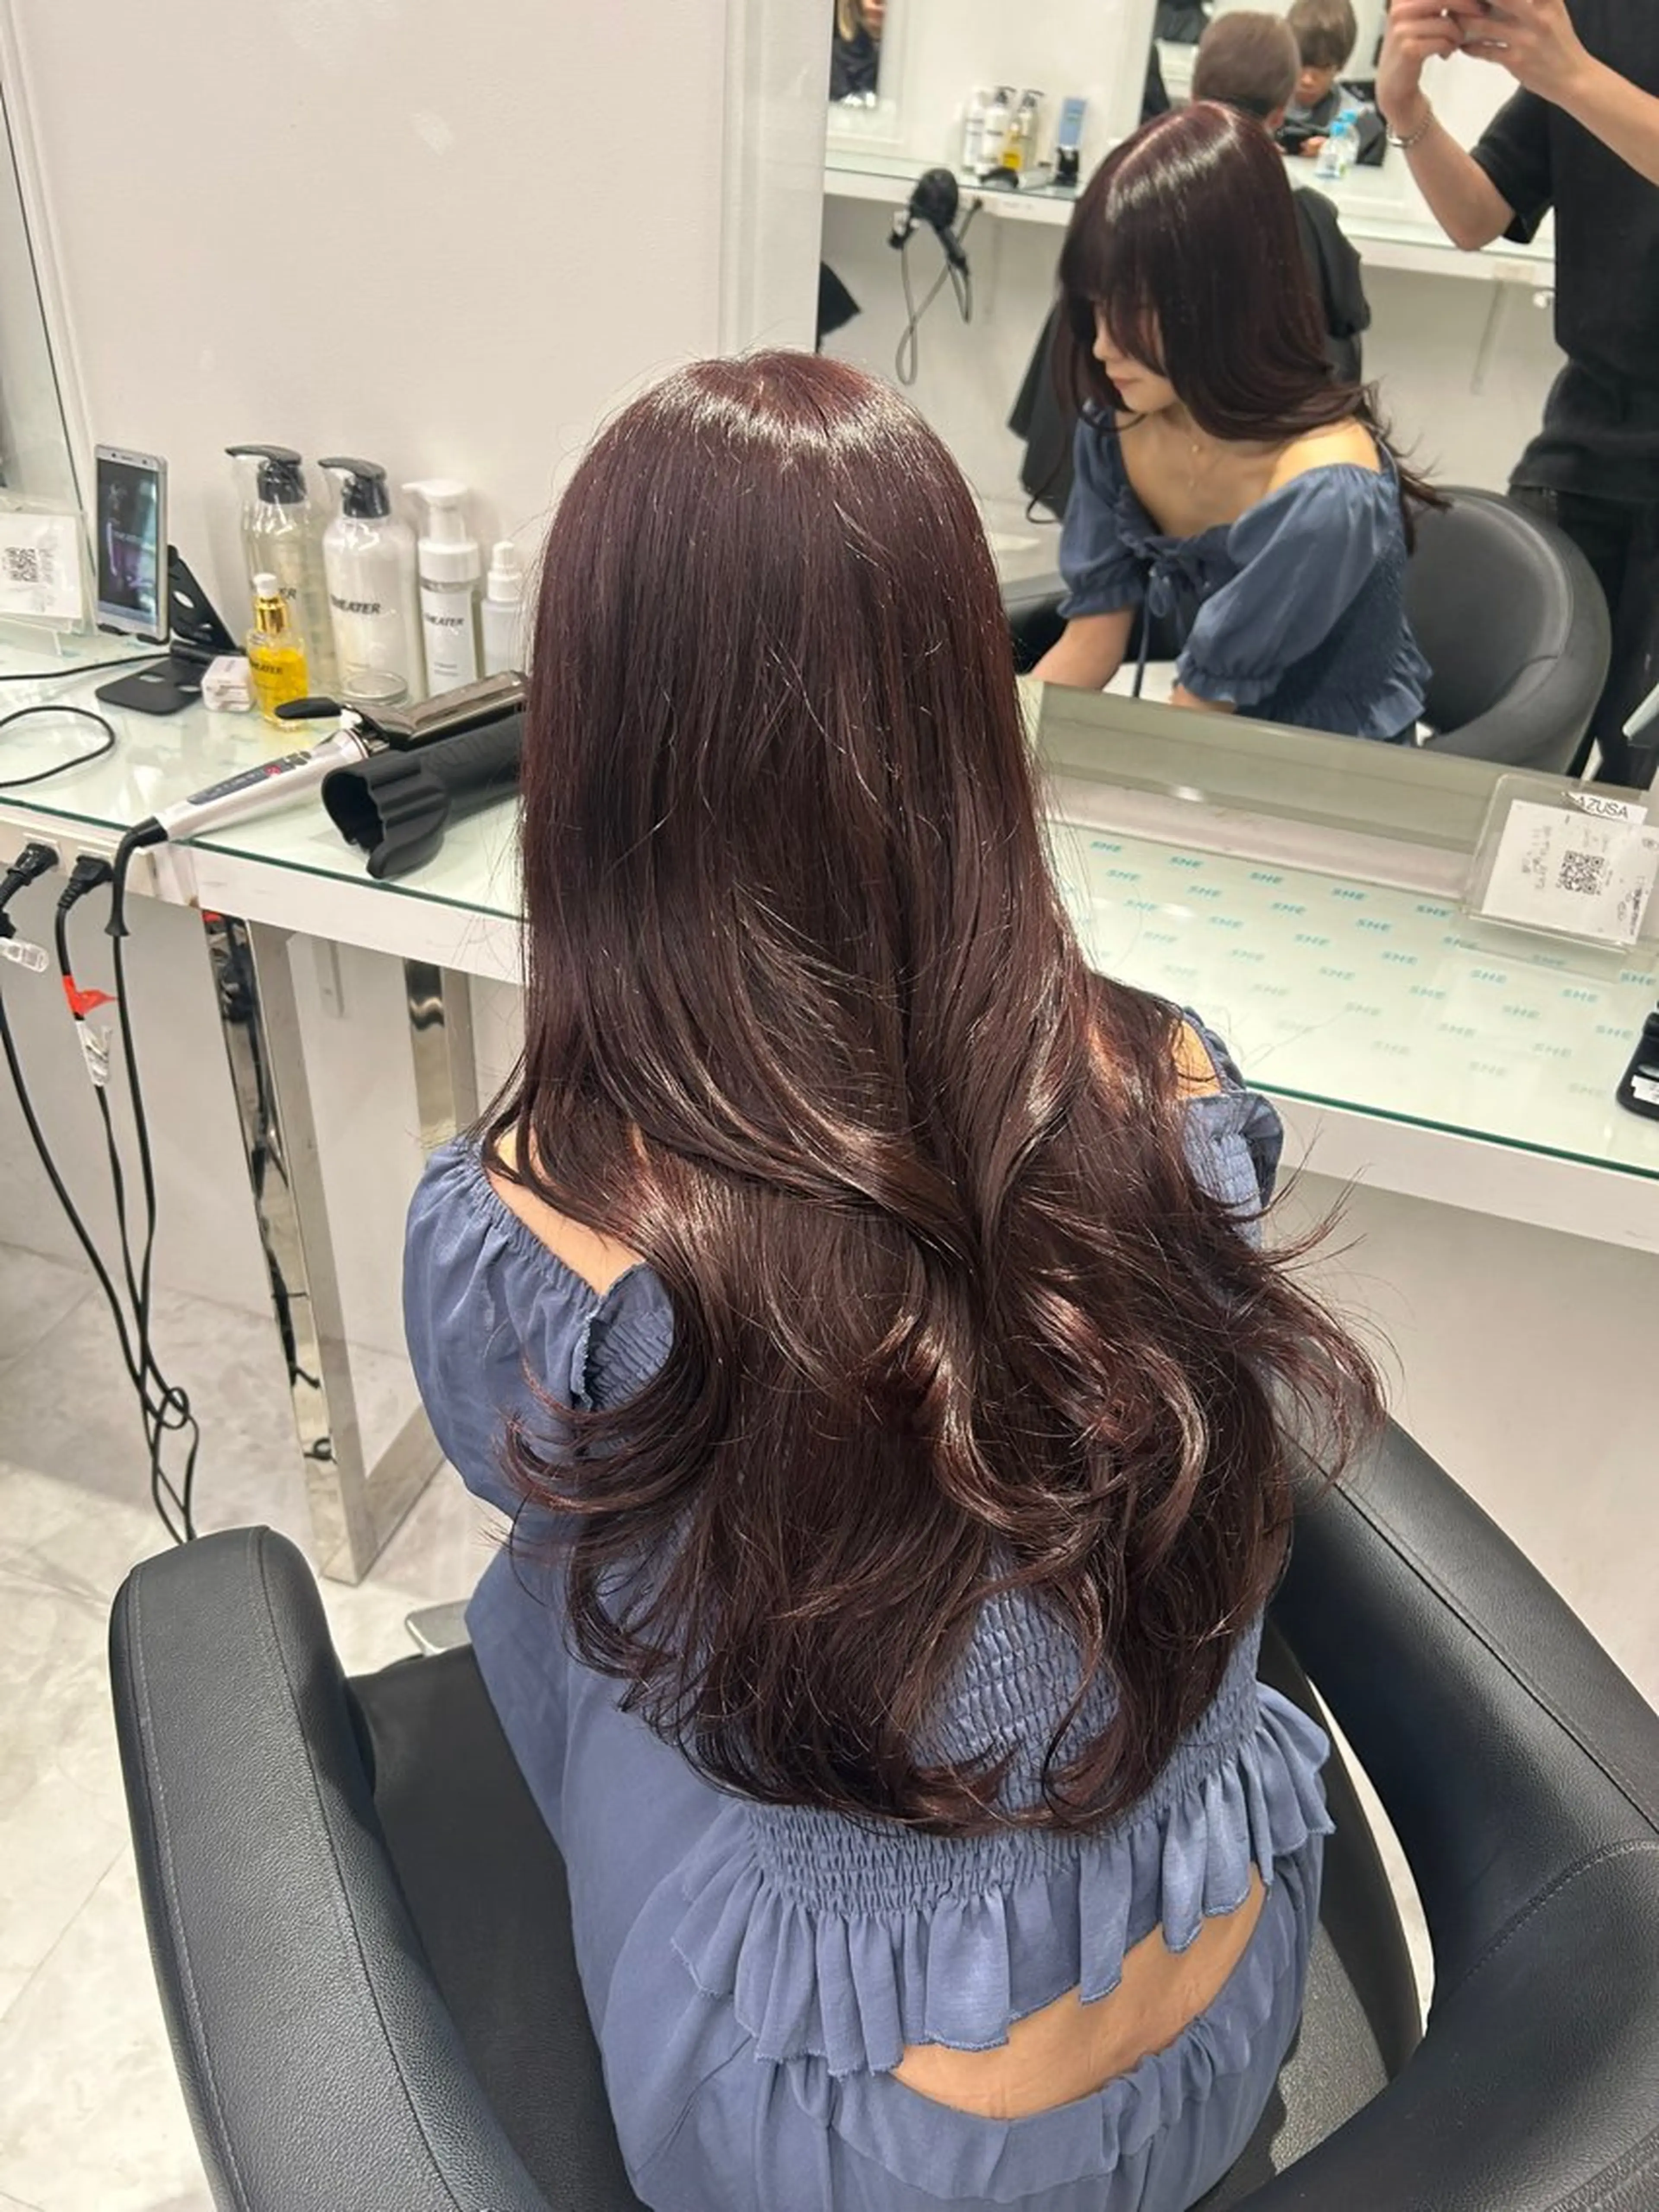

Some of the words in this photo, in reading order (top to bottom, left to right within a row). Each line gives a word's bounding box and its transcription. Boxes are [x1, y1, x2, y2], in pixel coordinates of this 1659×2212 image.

[1250, 872, 1284, 884] SHE
[1332, 888, 1367, 900] SHE
[1416, 905, 1452, 917] SHE
[1471, 969, 1506, 983] SHE
[1562, 988, 1598, 1002] SHE
